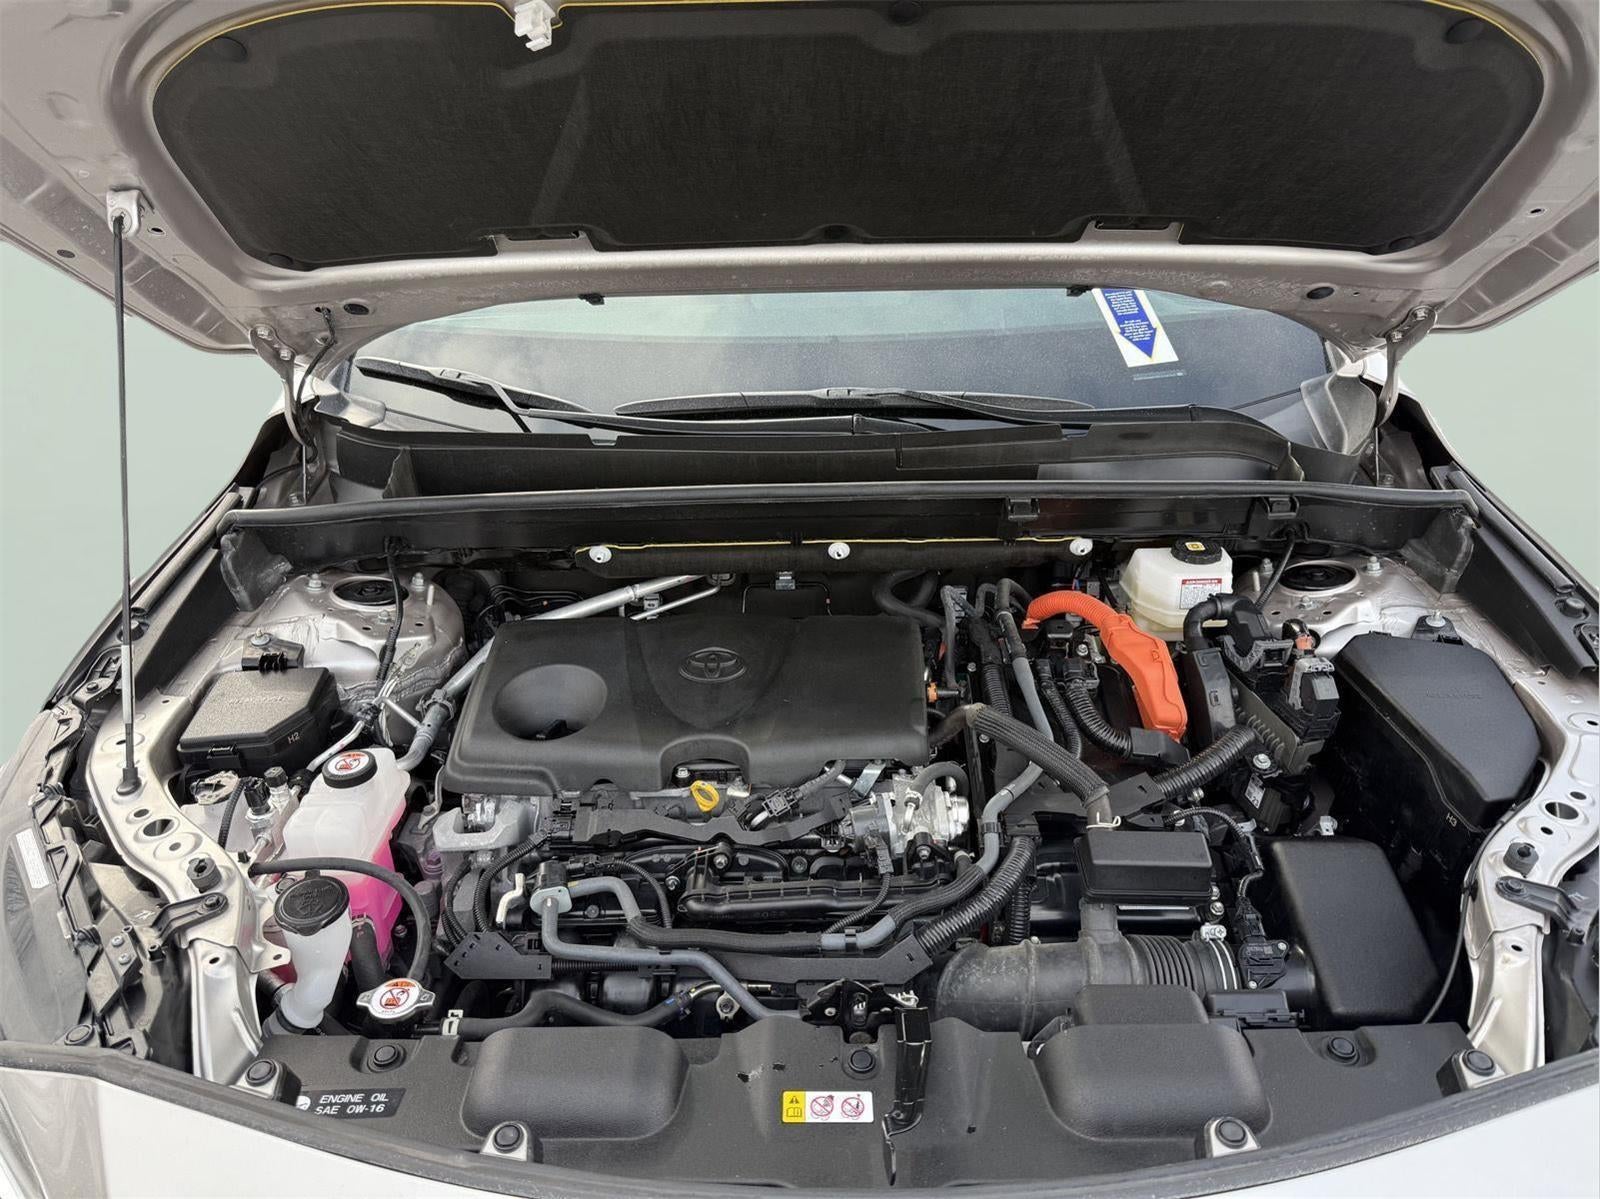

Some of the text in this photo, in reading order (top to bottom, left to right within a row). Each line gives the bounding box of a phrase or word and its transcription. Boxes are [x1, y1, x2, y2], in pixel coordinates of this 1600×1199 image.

[287, 731, 300, 744] H2
[1445, 812, 1458, 827] H3
[319, 1092, 390, 1104] ENGINE OIL
[314, 1103, 386, 1115] SAE 0W-16
